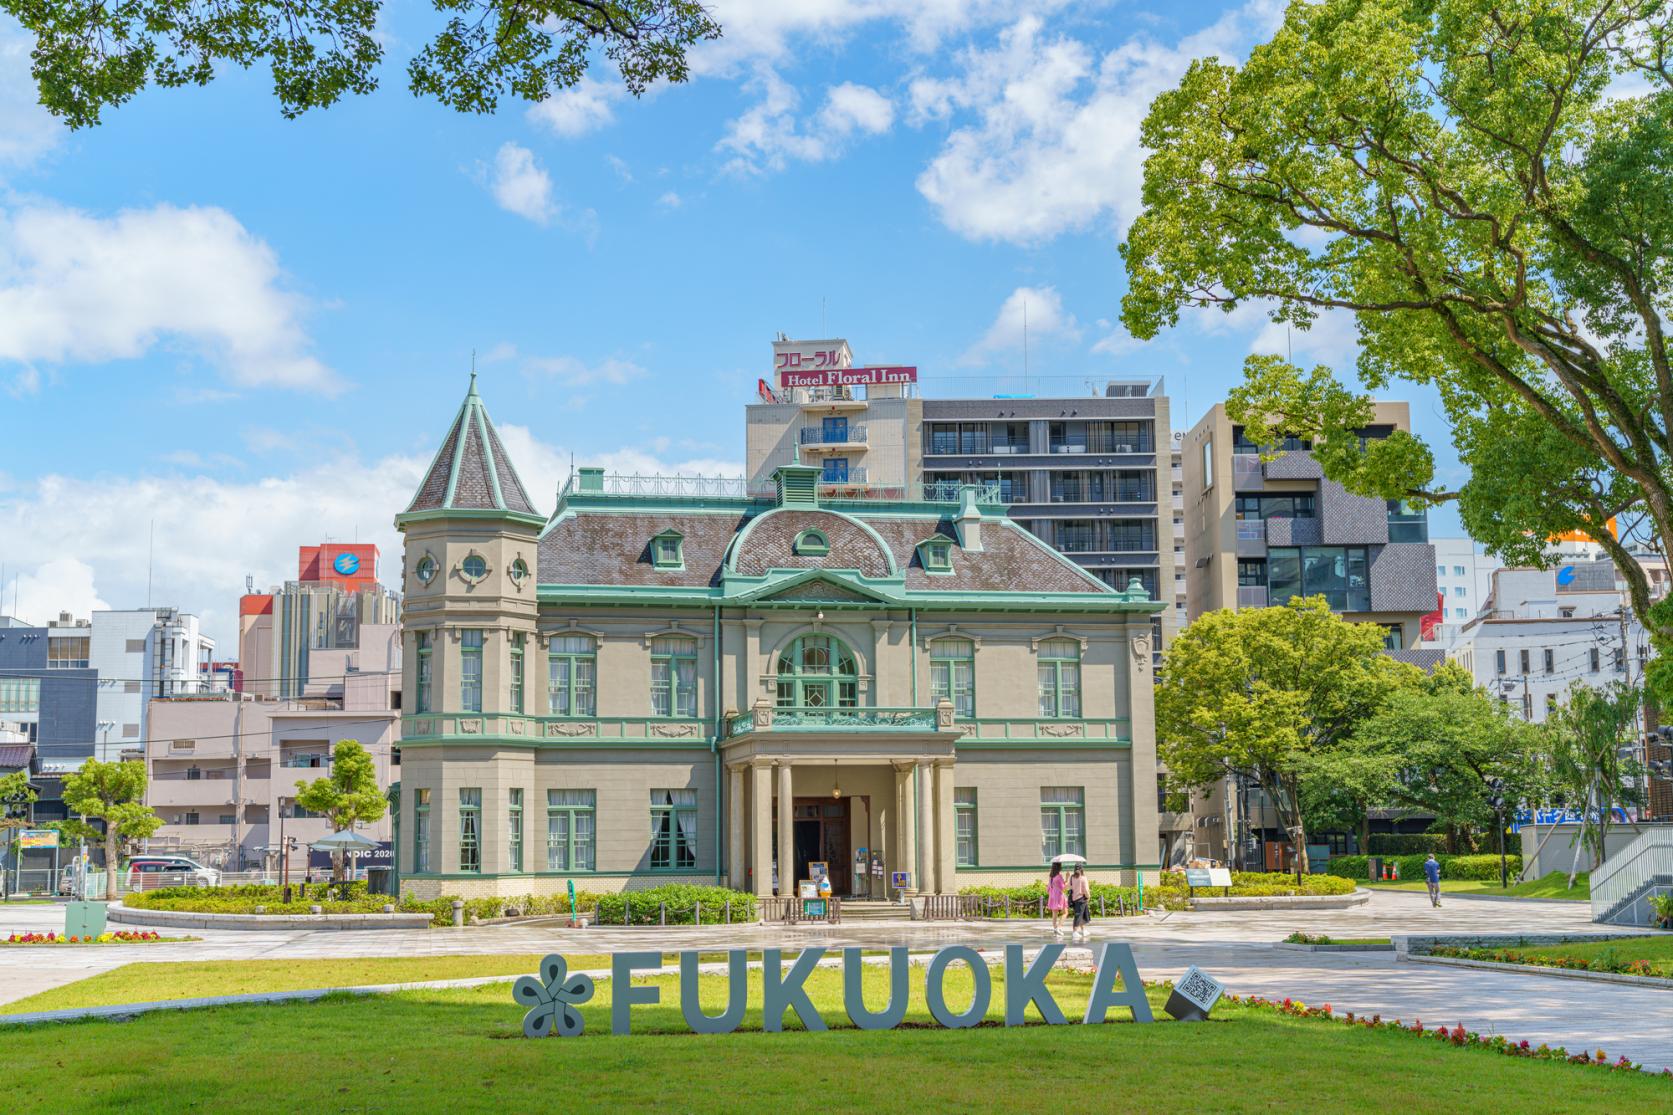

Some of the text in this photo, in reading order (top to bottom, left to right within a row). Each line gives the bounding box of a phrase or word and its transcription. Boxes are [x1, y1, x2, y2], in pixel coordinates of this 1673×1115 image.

[776, 350, 841, 369] フローラル
[788, 369, 912, 386] Hotel Floral Inn
[611, 943, 1155, 1035] FUKUOKA
